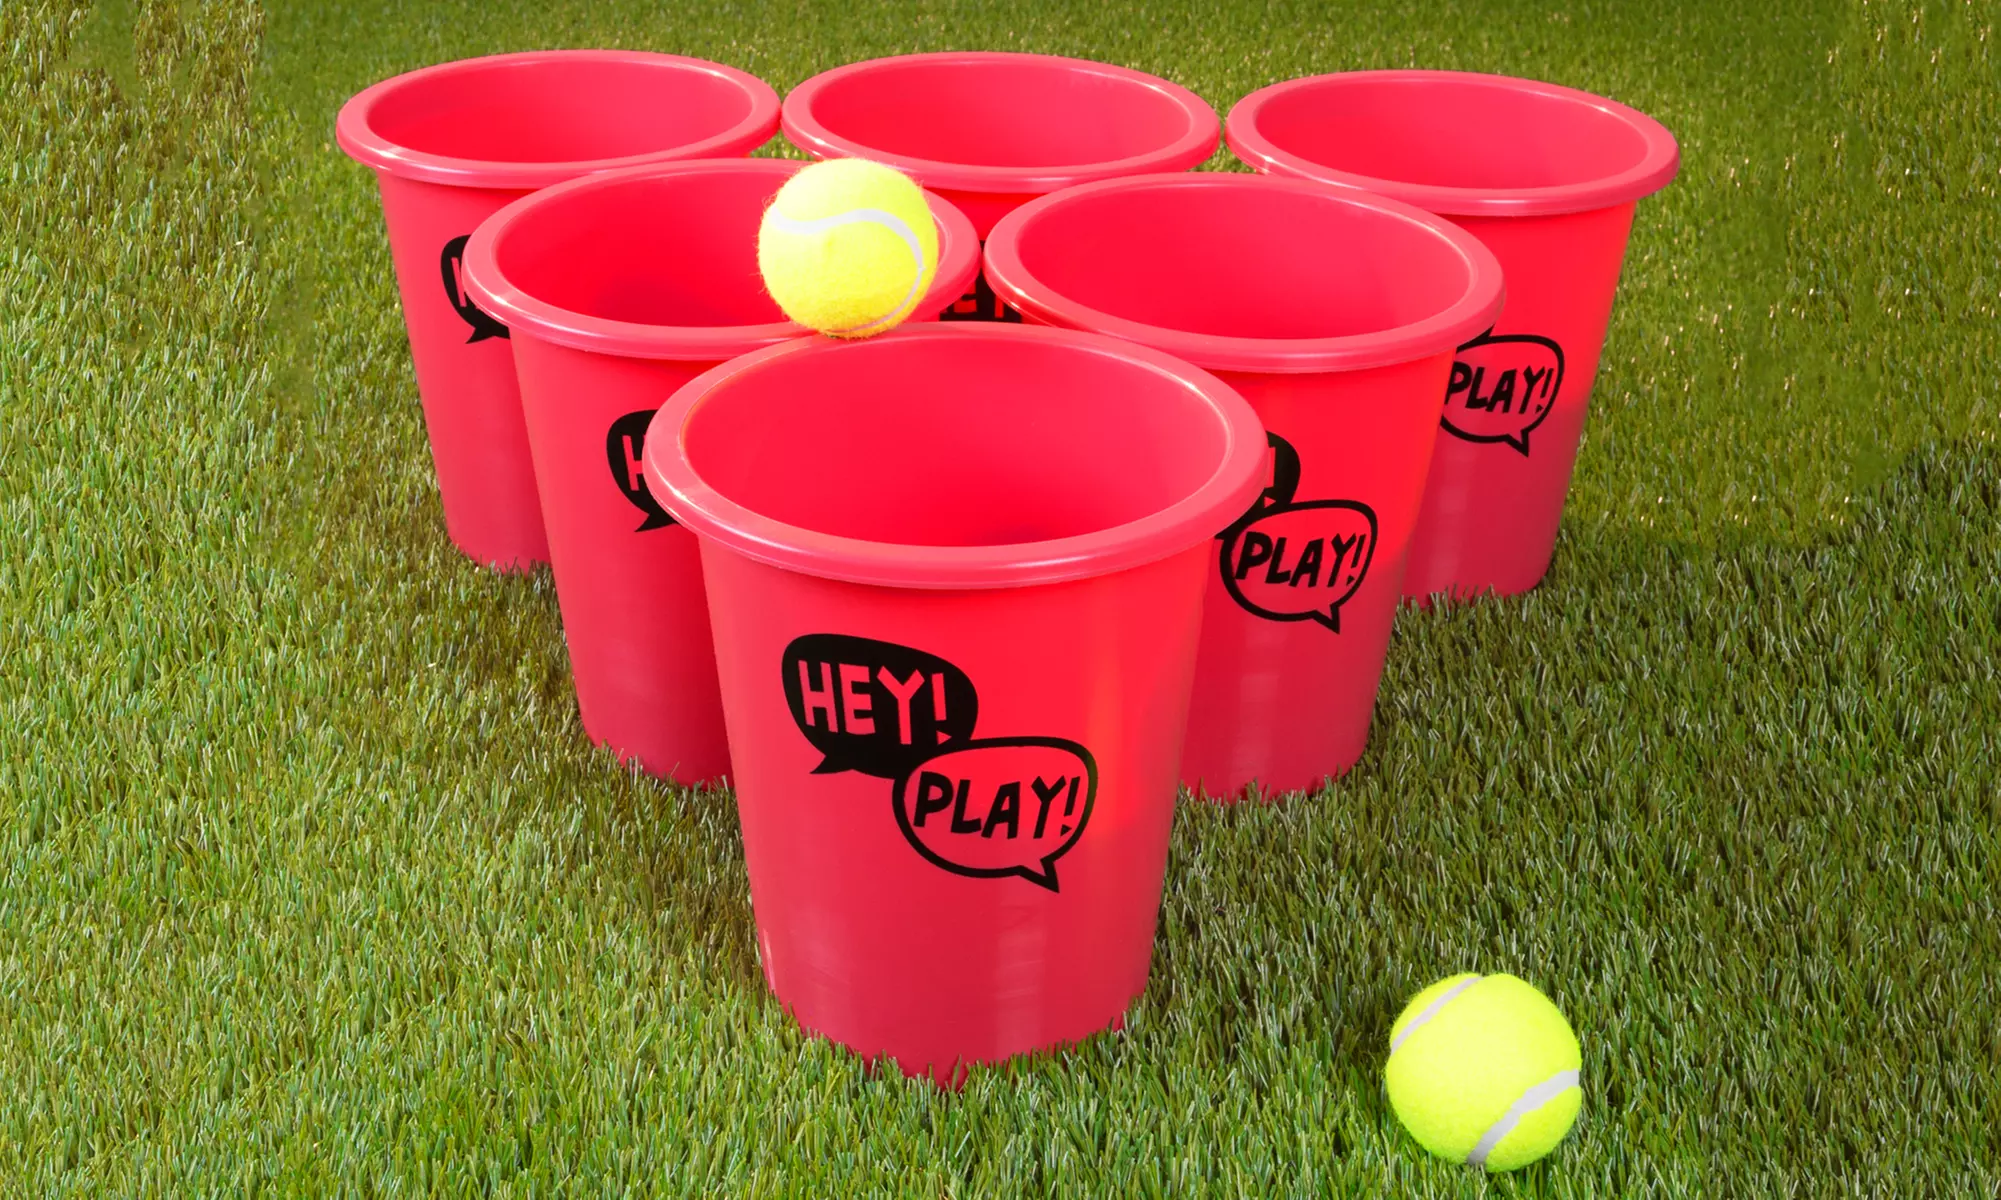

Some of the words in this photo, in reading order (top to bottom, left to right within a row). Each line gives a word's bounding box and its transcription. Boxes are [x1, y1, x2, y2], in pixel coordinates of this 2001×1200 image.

[1444, 361, 1554, 415] PLAY!
[1235, 531, 1367, 588] PLAY!
[798, 659, 952, 746] HEY!
[913, 771, 1081, 840] PLAY!
